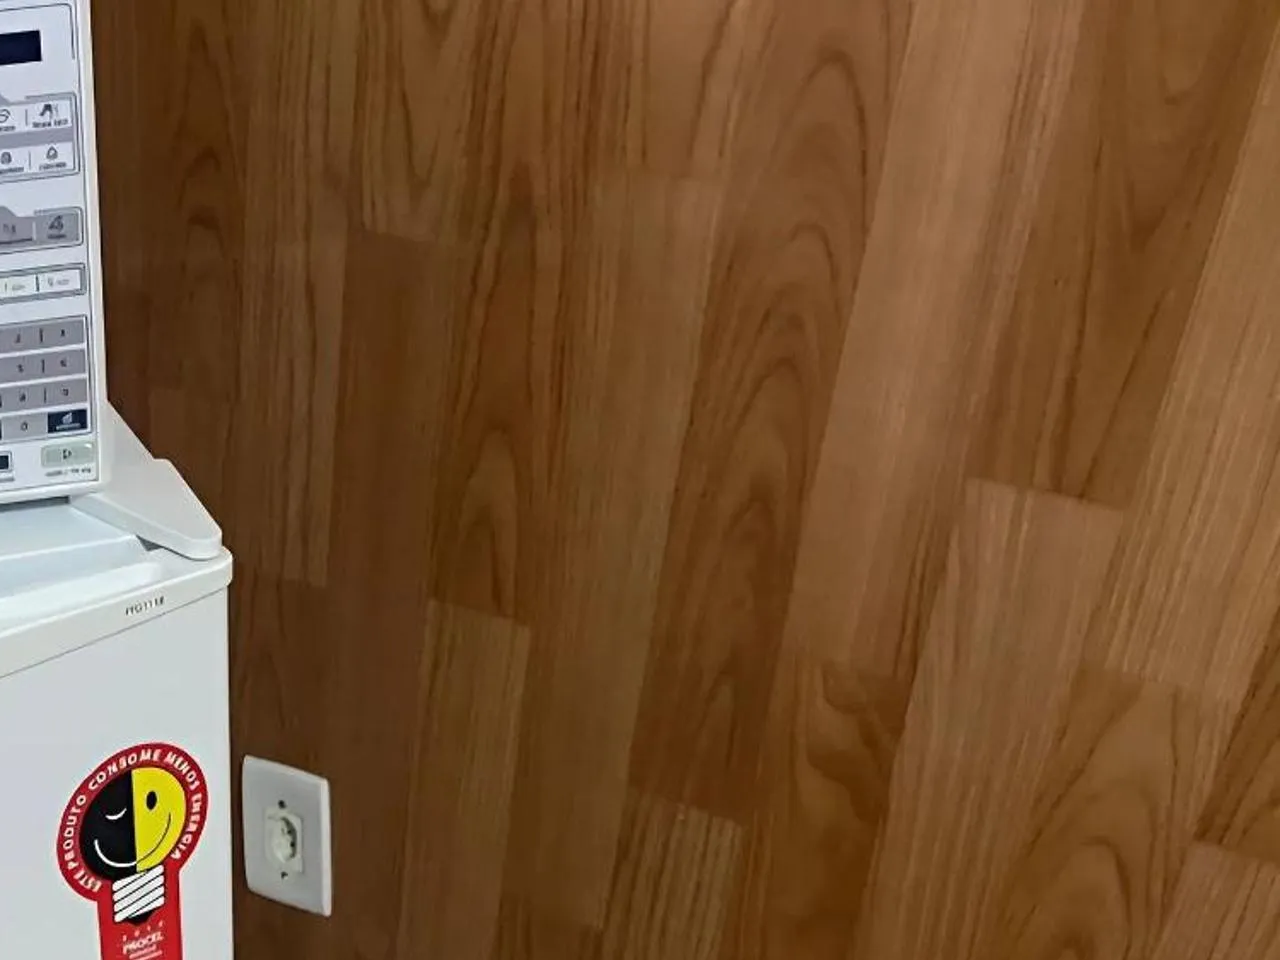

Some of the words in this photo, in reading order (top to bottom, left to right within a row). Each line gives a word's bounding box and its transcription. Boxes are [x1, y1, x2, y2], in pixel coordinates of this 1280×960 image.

[63, 795, 87, 870] PRODUTO
[88, 749, 163, 791] CONSOME
[164, 751, 201, 791] MENOS
